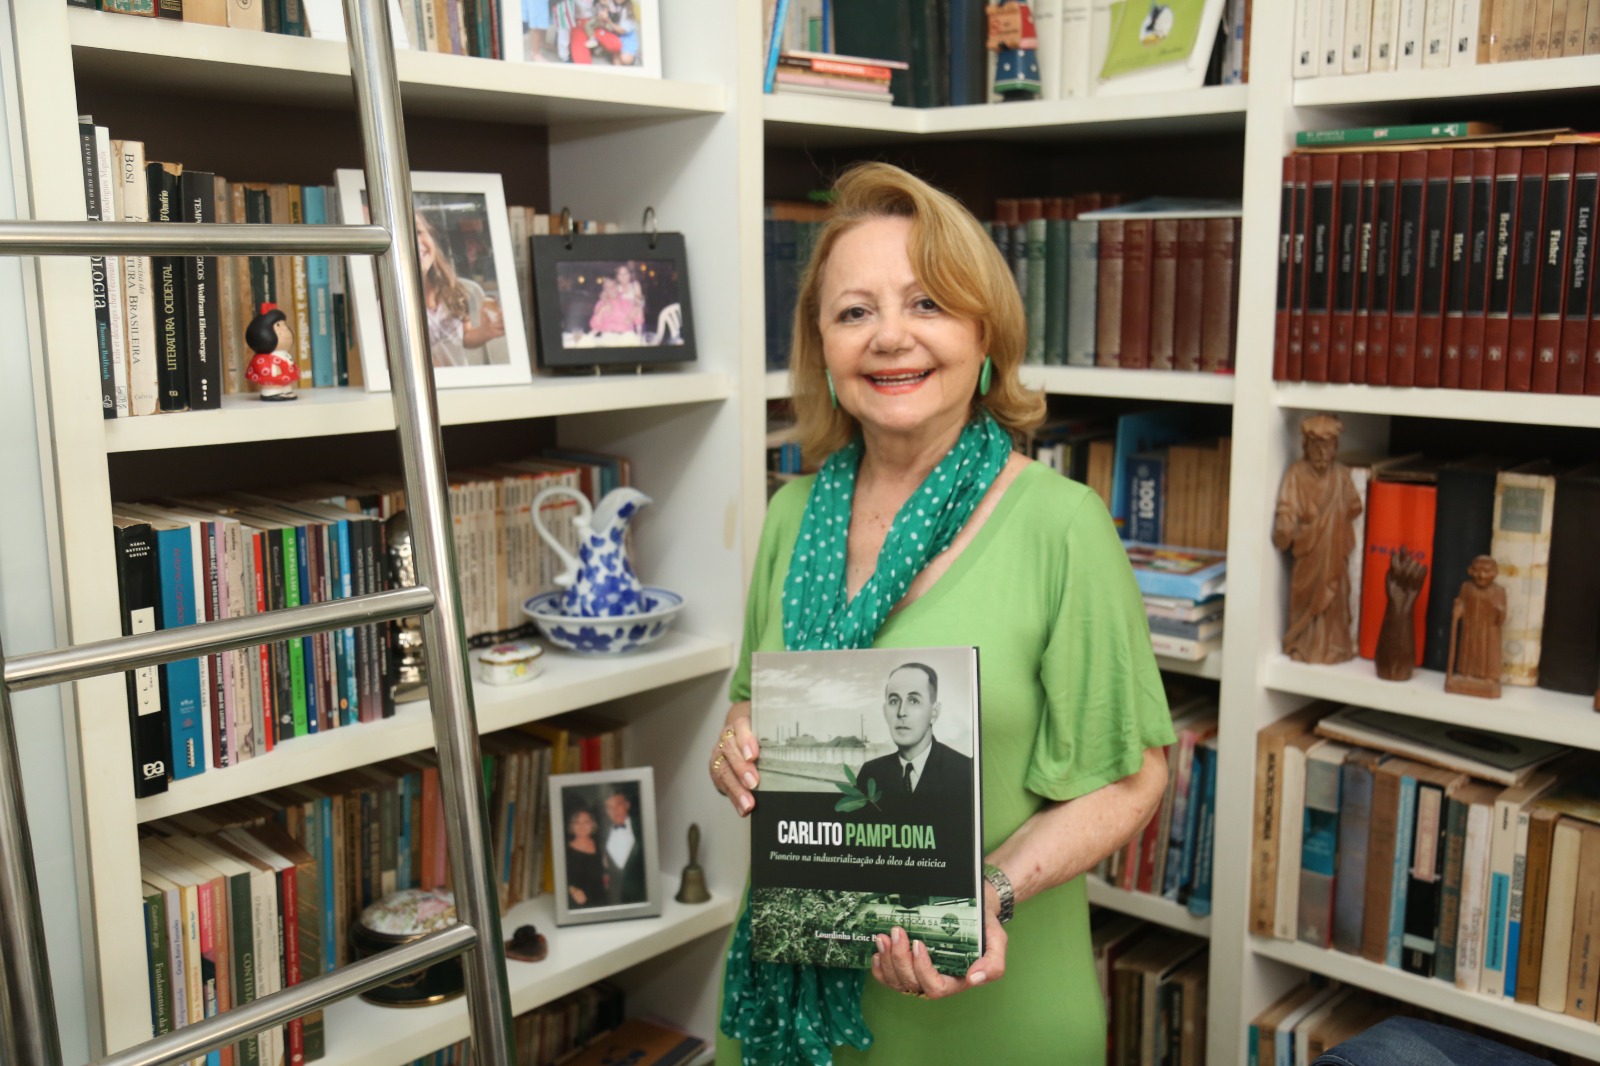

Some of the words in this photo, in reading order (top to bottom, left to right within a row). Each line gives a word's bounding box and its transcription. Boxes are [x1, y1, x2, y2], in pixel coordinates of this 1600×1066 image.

[124, 153, 135, 184] BOSI
[87, 168, 93, 177] DE
[90, 200, 95, 210] DA
[1548, 230, 1561, 265] Fisher
[163, 263, 174, 313] OCIDENTAL
[198, 283, 207, 317] Wolfram
[129, 295, 141, 365] BRASILEIRA
[166, 317, 177, 371] LITERATURA
[198, 317, 208, 363] Eilenberger
[1139, 479, 1155, 518] 1001
[777, 820, 843, 846] CARLITO
[845, 822, 937, 850] PAMPLONA
[769, 851, 801, 861] Pioneiro
[802, 854, 812, 862] na
[813, 852, 874, 867] industrialização
[875, 855, 885, 865] do
[886, 855, 903, 866] óleo
[904, 857, 915, 867] da
[917, 858, 947, 868] oiticica
[814, 929, 851, 940] Lourdinha
[852, 932, 871, 942] Leite
[155, 962, 165, 1015] Fundamentos
[243, 952, 256, 1002] CONTISTA
